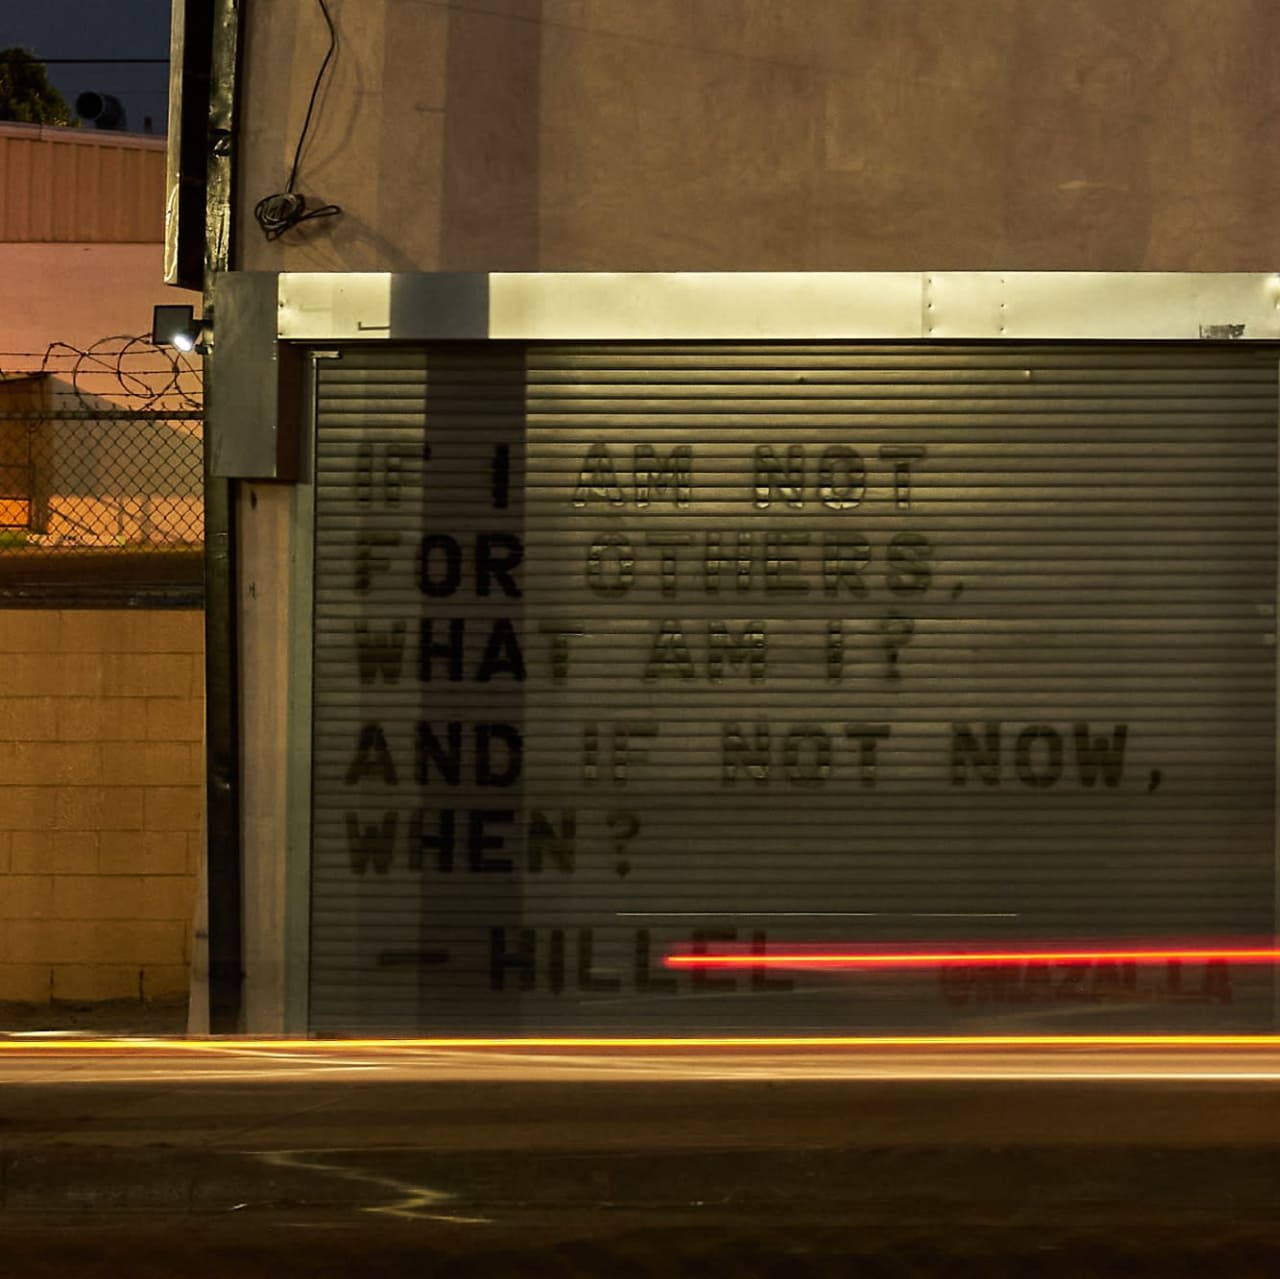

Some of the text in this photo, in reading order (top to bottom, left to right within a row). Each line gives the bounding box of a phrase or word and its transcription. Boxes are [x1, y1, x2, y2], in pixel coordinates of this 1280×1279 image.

[354, 442, 928, 511] IF I AM NOT
[354, 531, 967, 599] FOR OTHERS,
[354, 617, 585, 685] WHAT
[642, 617, 768, 685] AM
[345, 720, 1164, 794] AND IF NOT NOW,
[489, 926, 796, 995] HILLEL
